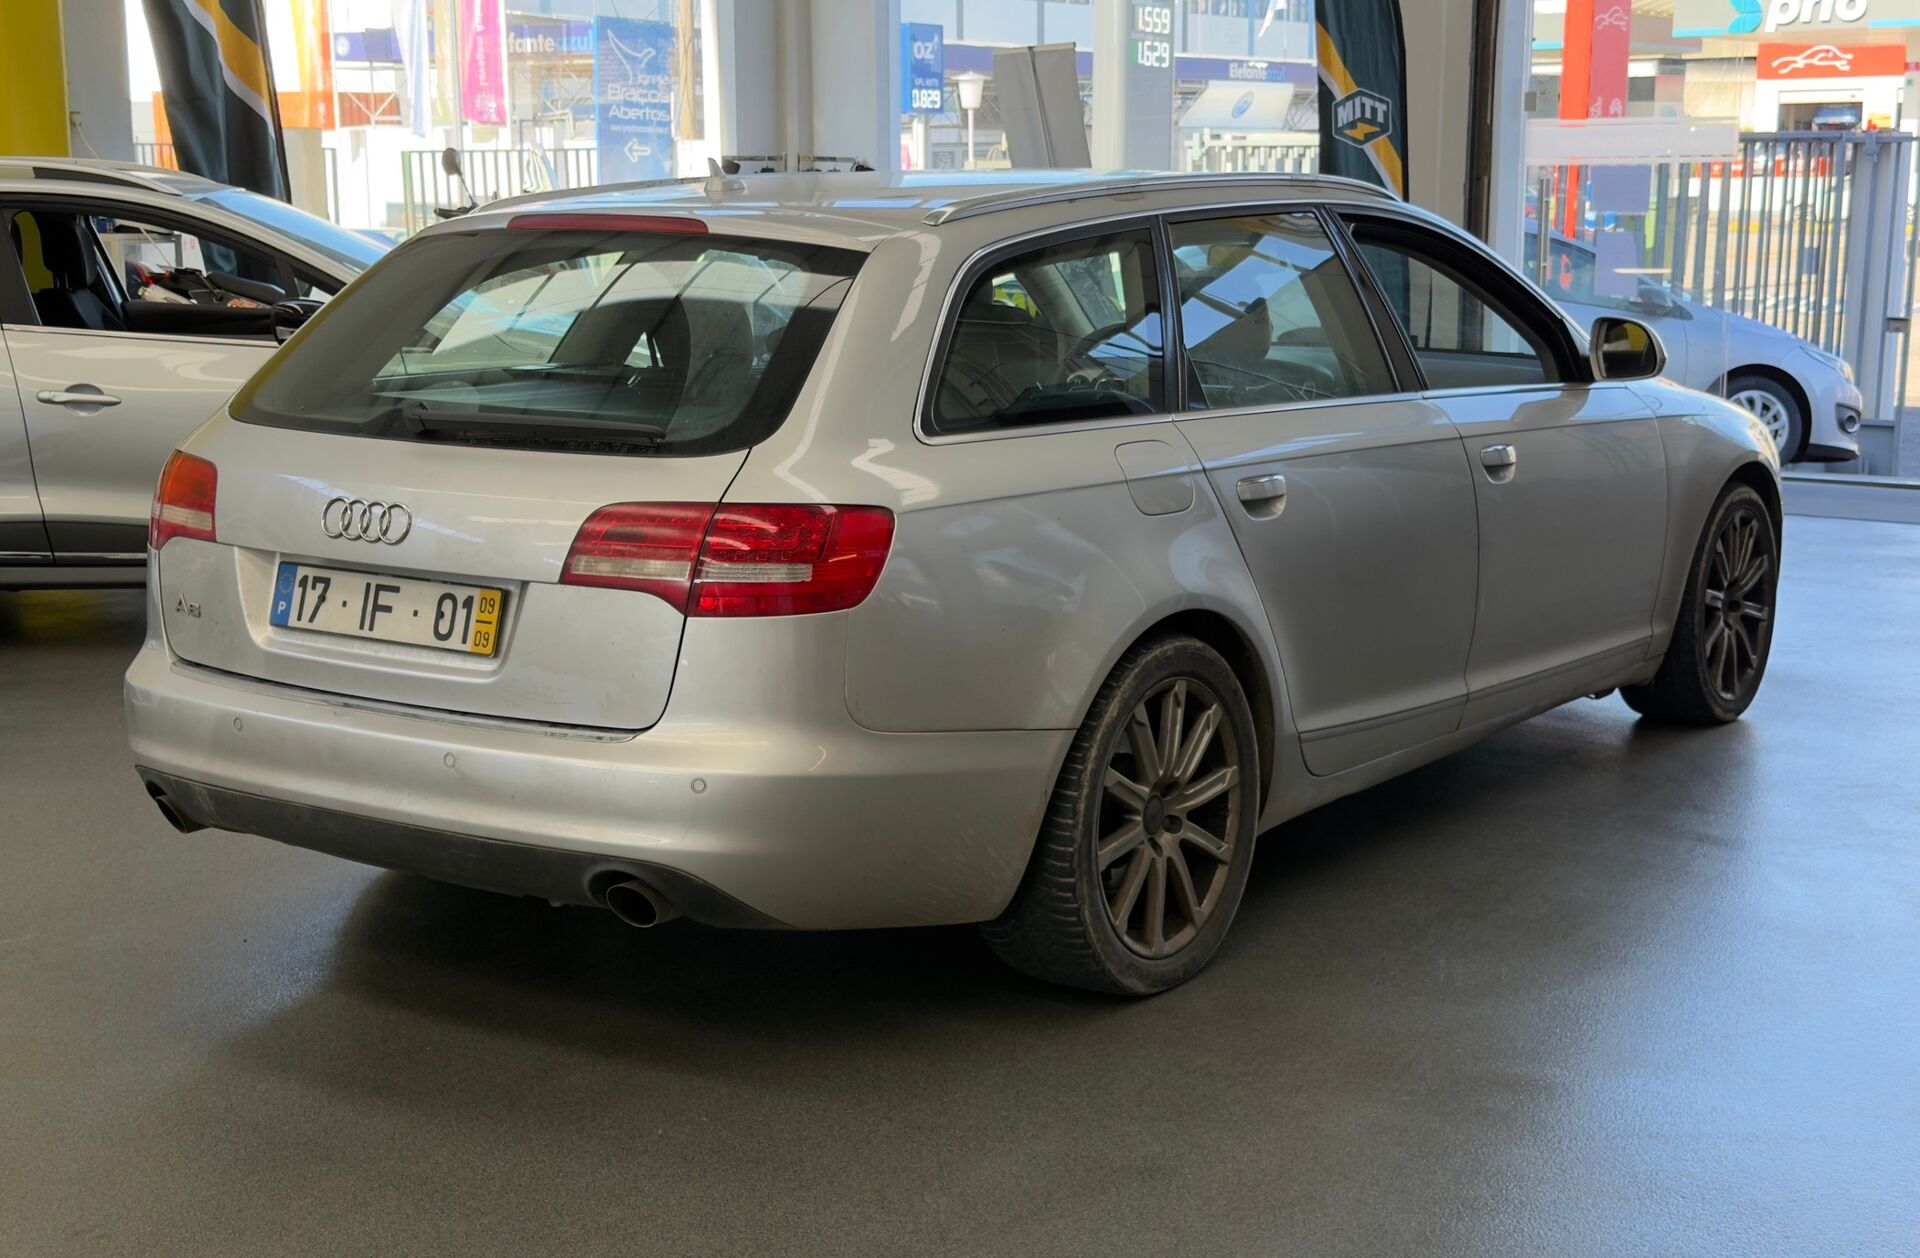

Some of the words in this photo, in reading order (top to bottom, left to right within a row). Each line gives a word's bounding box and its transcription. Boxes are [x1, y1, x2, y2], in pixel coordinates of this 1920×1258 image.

[1138, 6, 1170, 34] 1.559
[1764, 0, 1868, 33] prio
[1137, 40, 1169, 68] 1.629
[608, 104, 670, 122] Abertos
[1337, 96, 1388, 129] MITT
[278, 601, 286, 615] P
[480, 597, 495, 614] 09
[474, 630, 490, 648] 09
